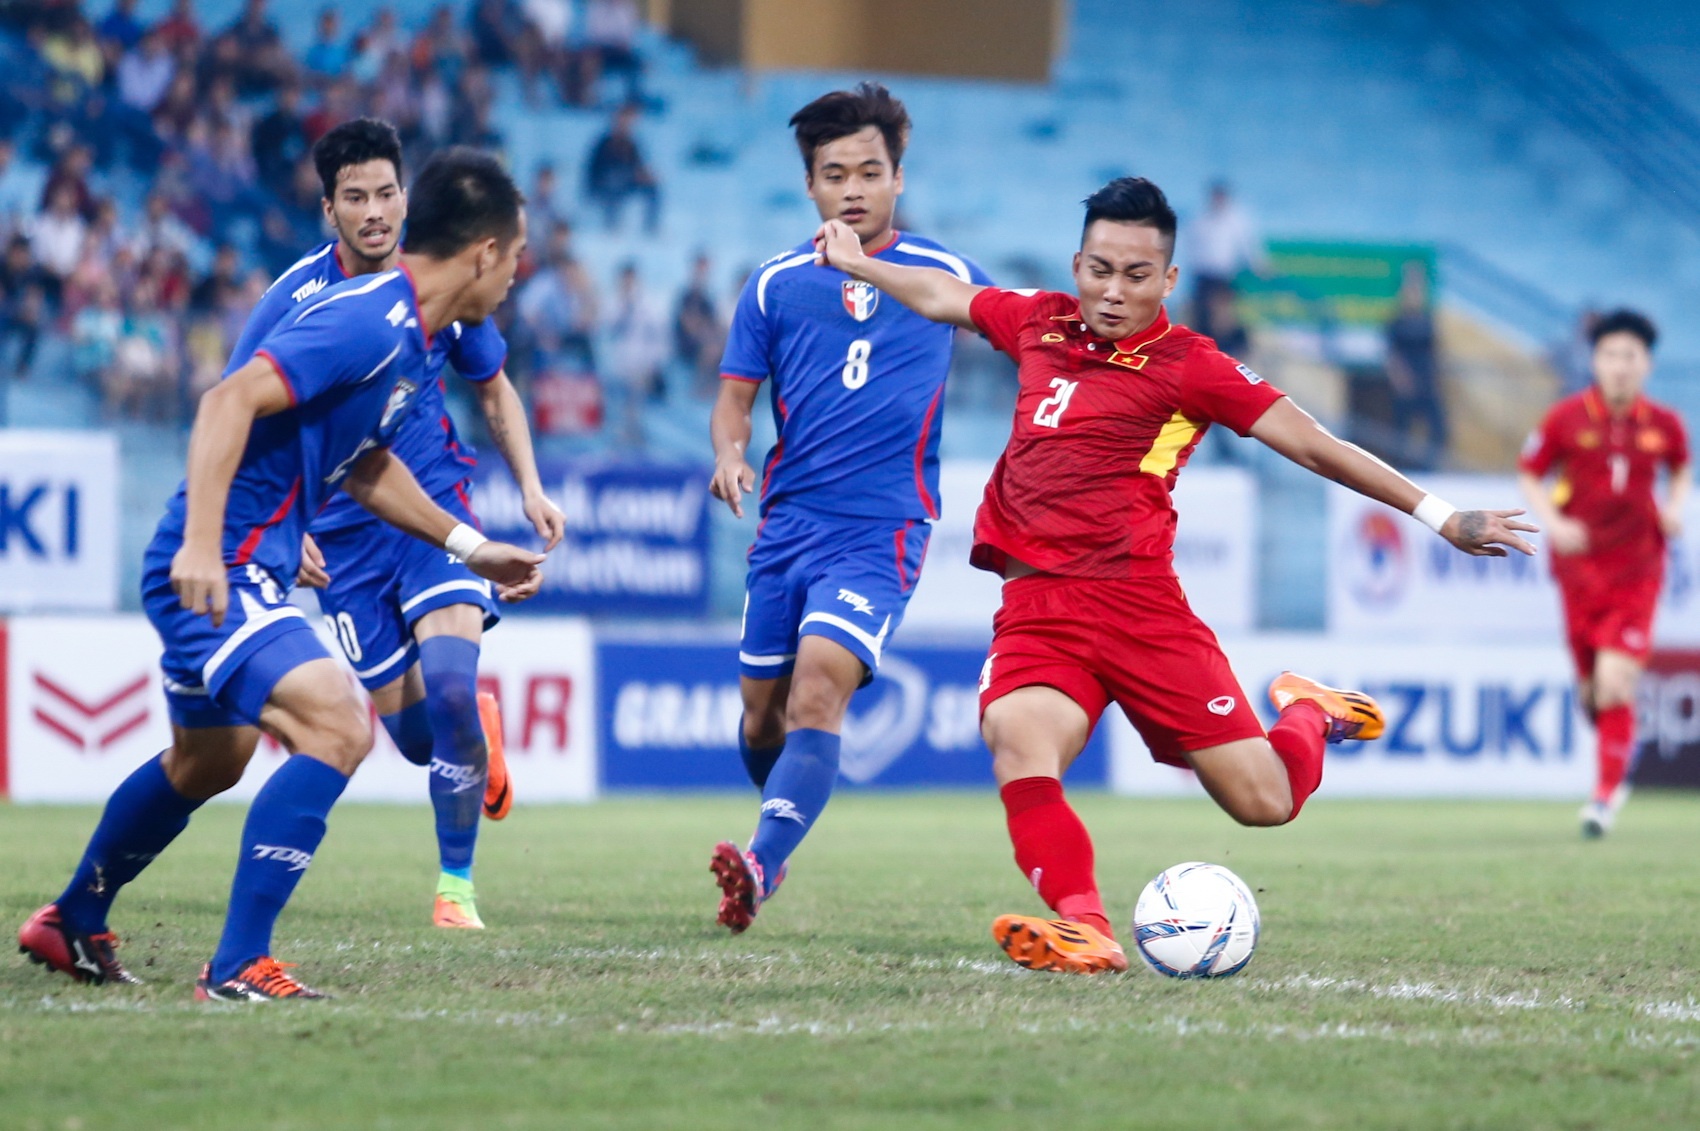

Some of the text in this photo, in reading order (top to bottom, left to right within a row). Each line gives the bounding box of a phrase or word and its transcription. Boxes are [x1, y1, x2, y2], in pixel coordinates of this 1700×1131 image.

[842, 339, 871, 390] 8
[1032, 376, 1079, 429] 21
[612, 681, 741, 749] GRAN
[1263, 681, 1576, 758] ZUKI
